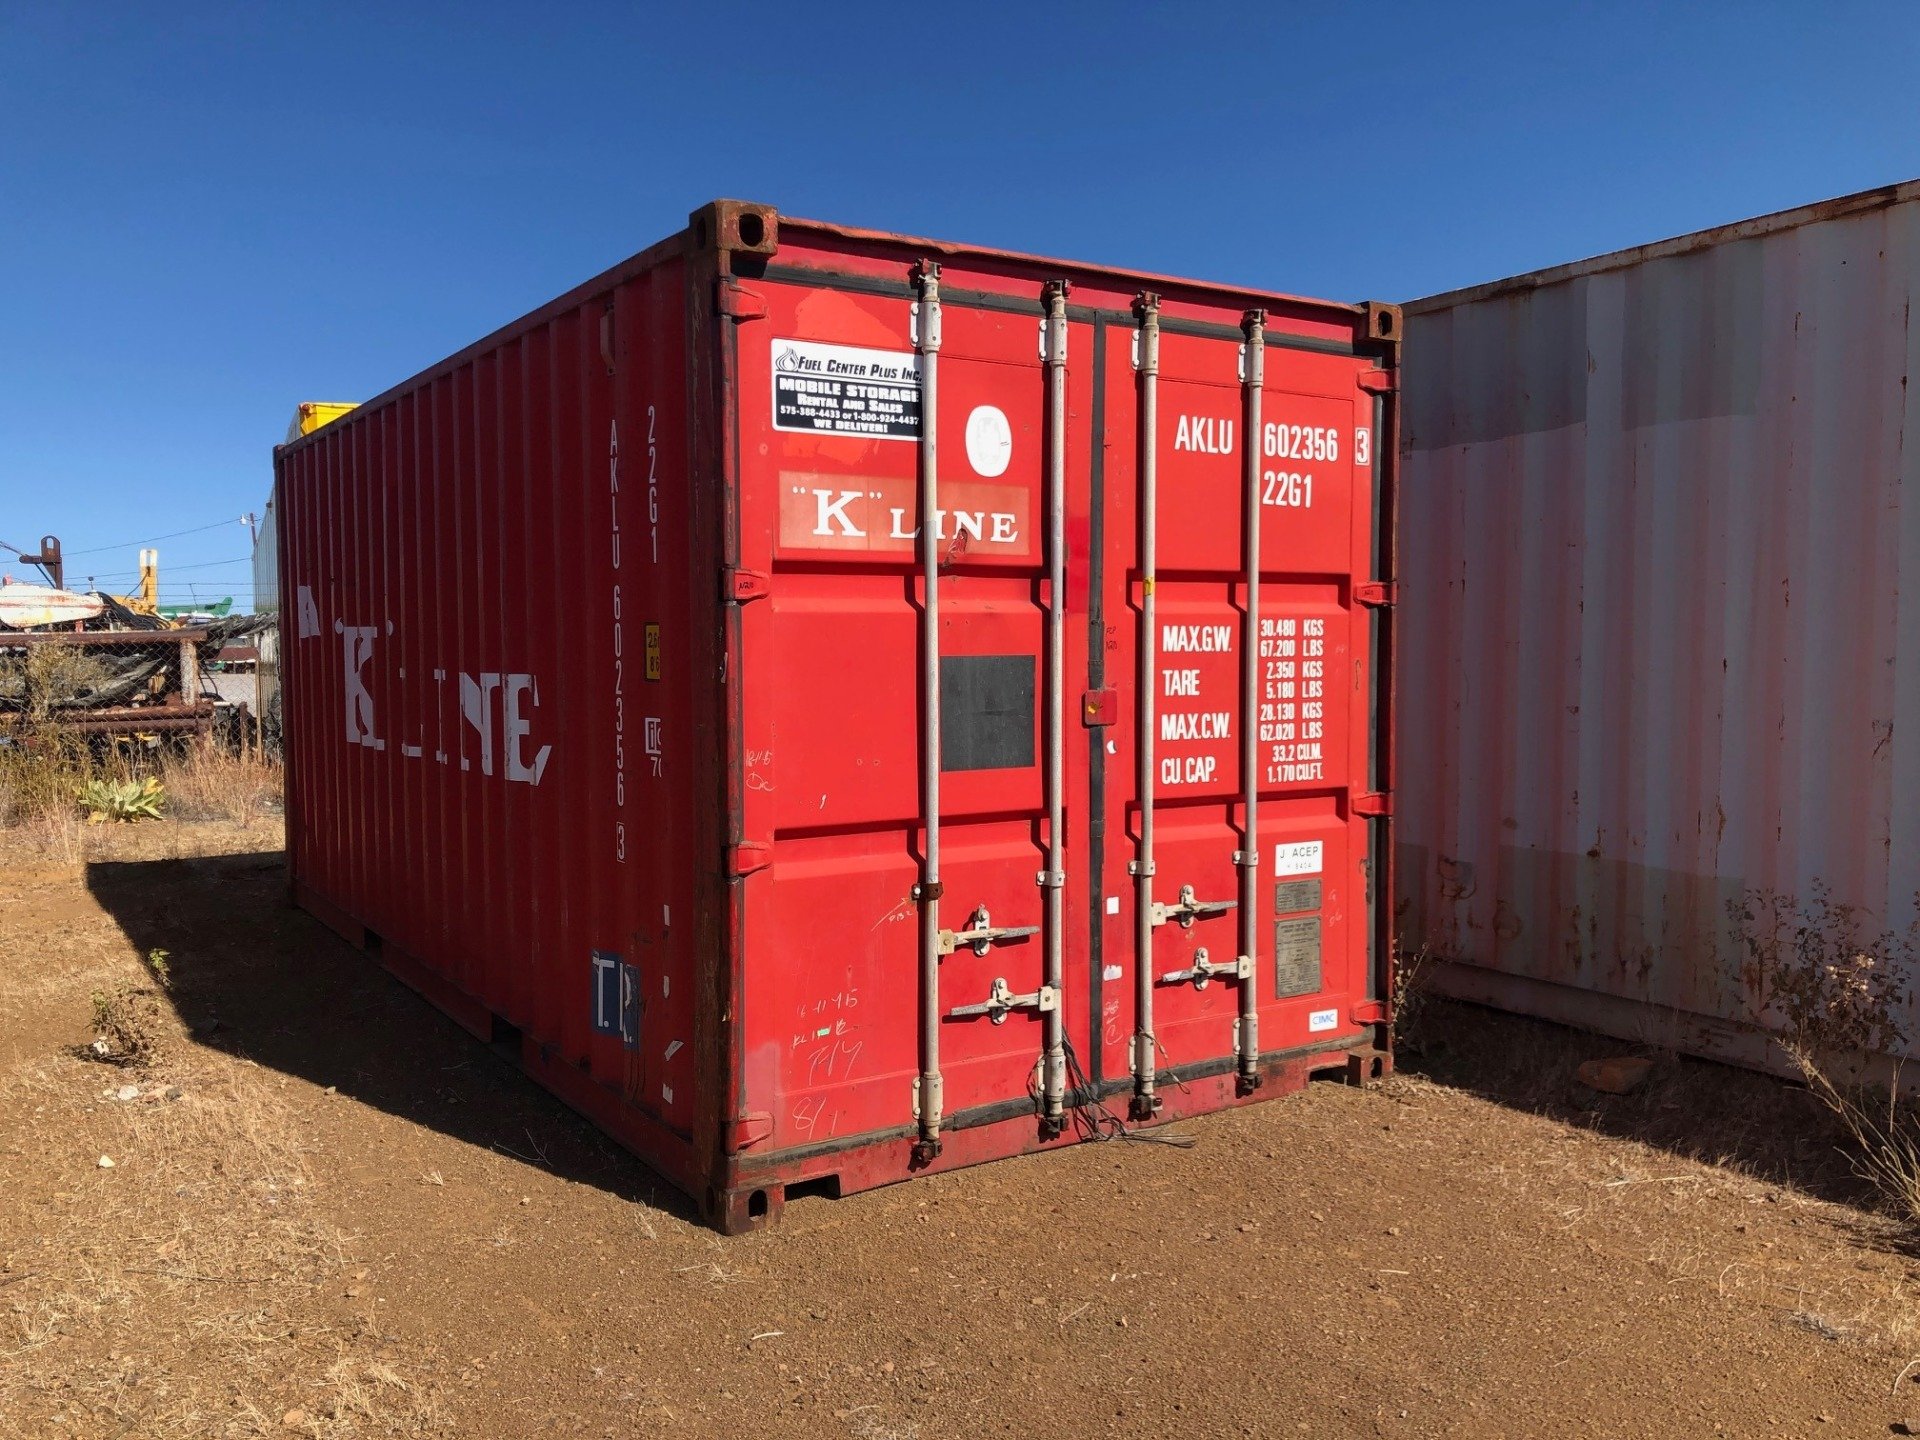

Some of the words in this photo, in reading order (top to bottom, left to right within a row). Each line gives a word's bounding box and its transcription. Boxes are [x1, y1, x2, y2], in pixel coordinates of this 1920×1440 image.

[827, 359, 866, 375] CENTER
[870, 364, 898, 379] PLUS
[779, 377, 841, 395] MOBILE
[846, 384, 919, 403] STORAGE
[868, 400, 903, 414] SALES
[813, 419, 832, 429] WE
[835, 420, 888, 433] DELIVER!
[1173, 414, 1233, 455] AKLU
[1264, 422, 1338, 462] 602356
[1357, 430, 1368, 463] 3
[647, 405, 658, 564] 22G1
[1262, 470, 1312, 508] 22G1
[610, 419, 621, 570] AKLU
[889, 507, 1019, 543] LINE
[1303, 618, 1324, 637] KGS
[1302, 639, 1324, 657] LBS
[1302, 660, 1323, 678] KGS
[1162, 669, 1200, 696] TARE
[1302, 681, 1323, 699] LBS
[613, 584, 625, 807] 602356
[1302, 701, 1322, 720] KGS
[1302, 721, 1322, 739] LBS
[1272, 744, 1294, 763] 33.2
[1292, 845, 1319, 858] ACEP
